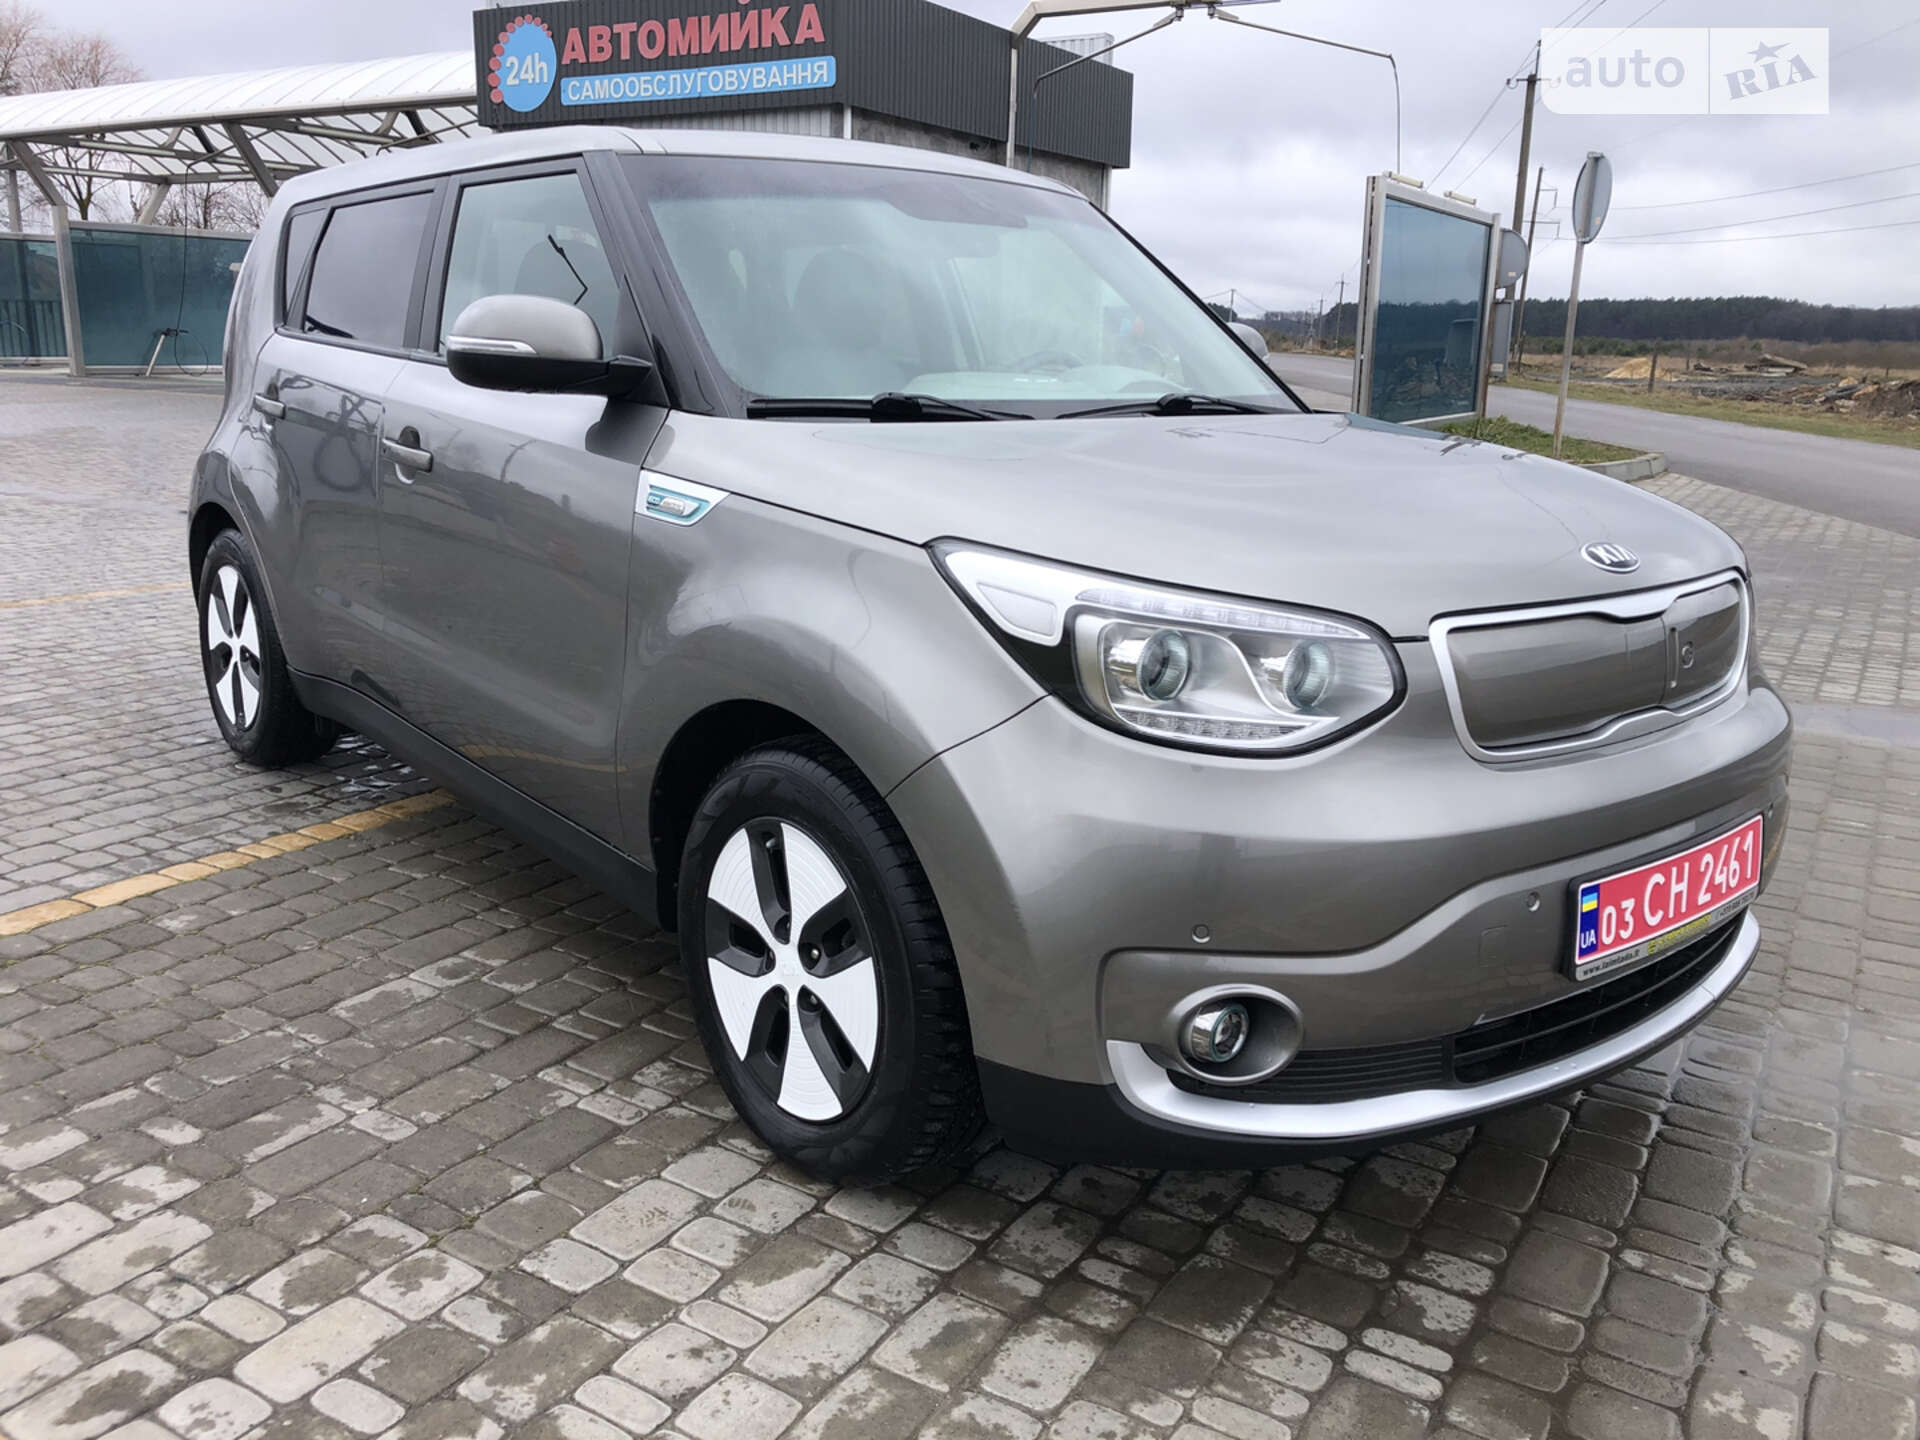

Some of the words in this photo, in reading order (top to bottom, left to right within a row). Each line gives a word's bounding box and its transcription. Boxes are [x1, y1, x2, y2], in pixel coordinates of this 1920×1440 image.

[561, 0, 826, 65] АВТОМИЙКА
[506, 53, 548, 86] 24h
[567, 60, 828, 102] САМООБСЛУГОВУВАННЯ
[1601, 897, 1636, 946] 03
[1697, 830, 1754, 906] 2461
[1580, 928, 1597, 949] UA
